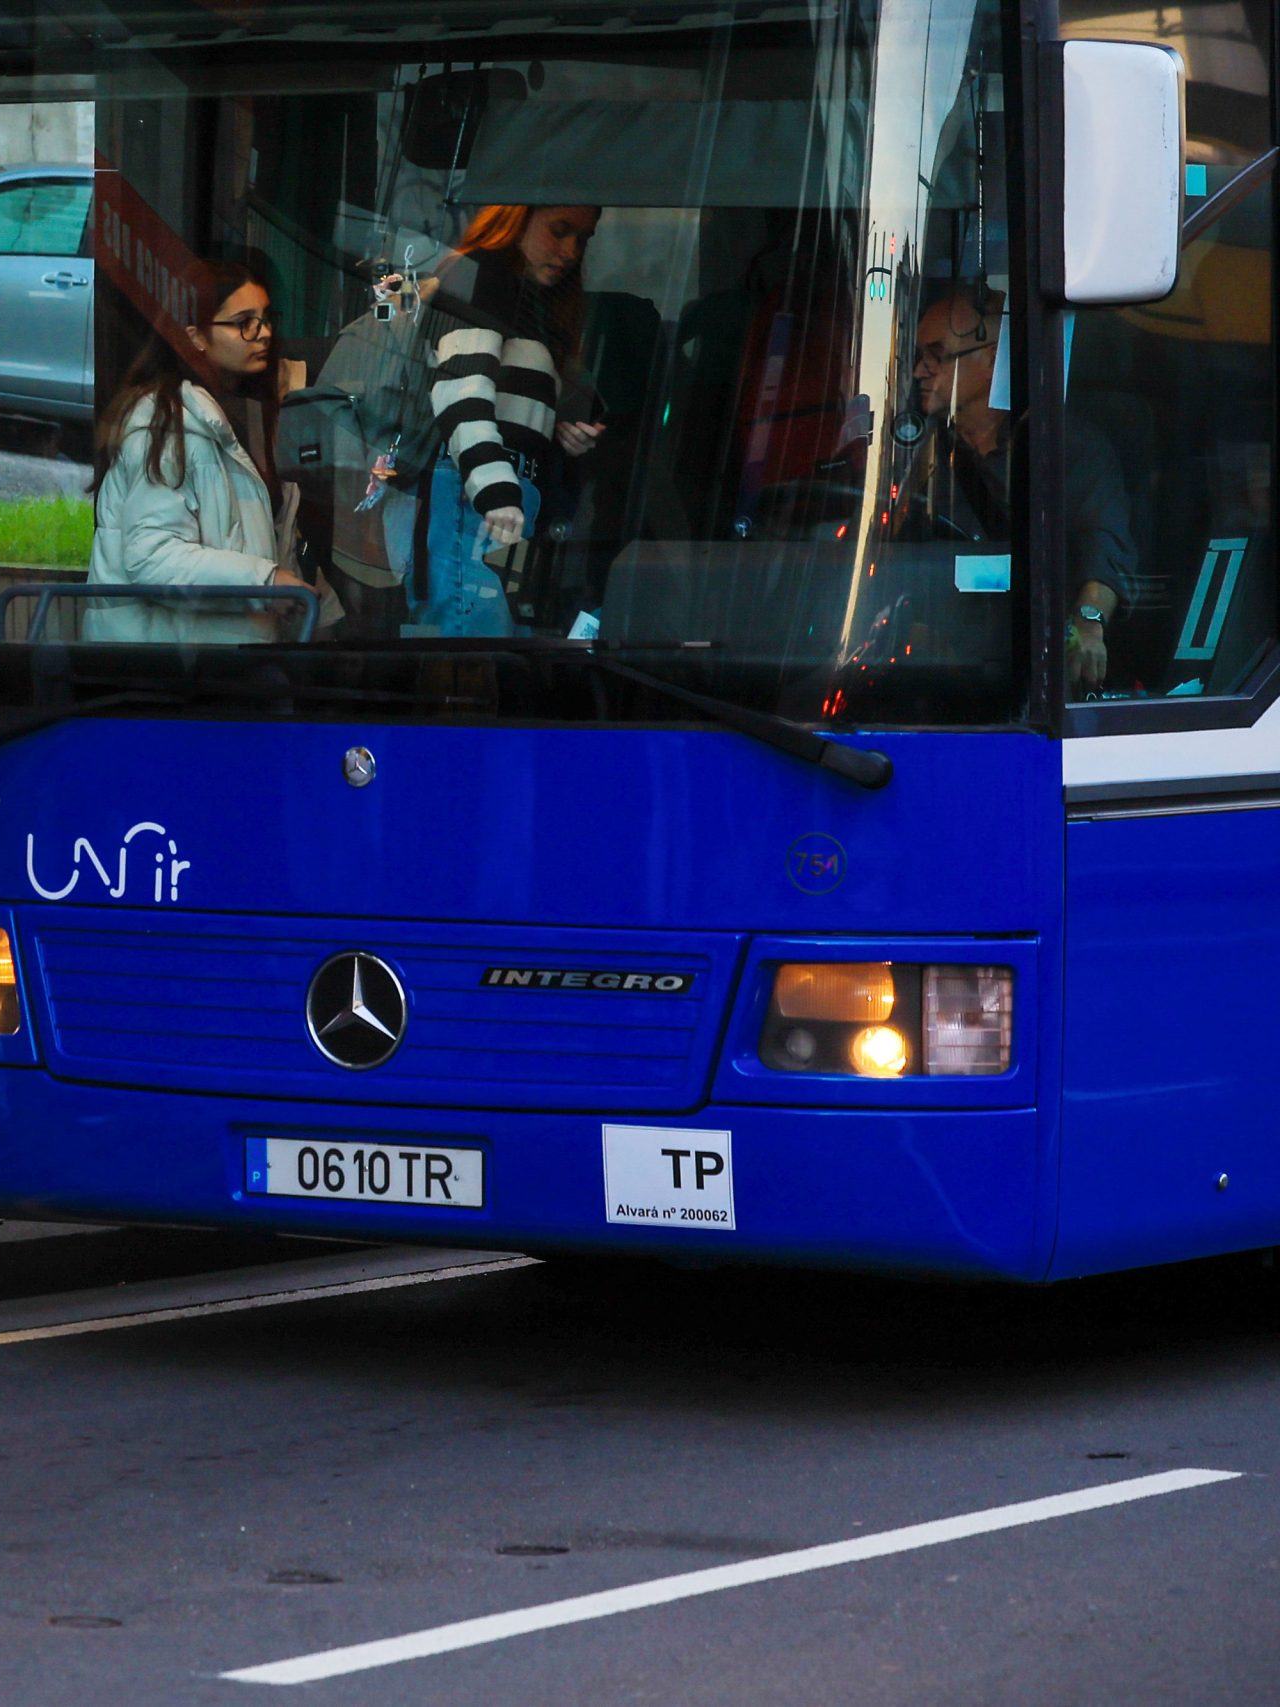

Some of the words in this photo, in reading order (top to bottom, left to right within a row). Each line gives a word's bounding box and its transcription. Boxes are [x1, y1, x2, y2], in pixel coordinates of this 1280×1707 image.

[795, 851, 839, 877] 751
[488, 969, 684, 991] INTEGRO
[661, 1148, 725, 1190] TP
[616, 1203, 659, 1219] Alvará
[680, 1208, 728, 1222] 200062
